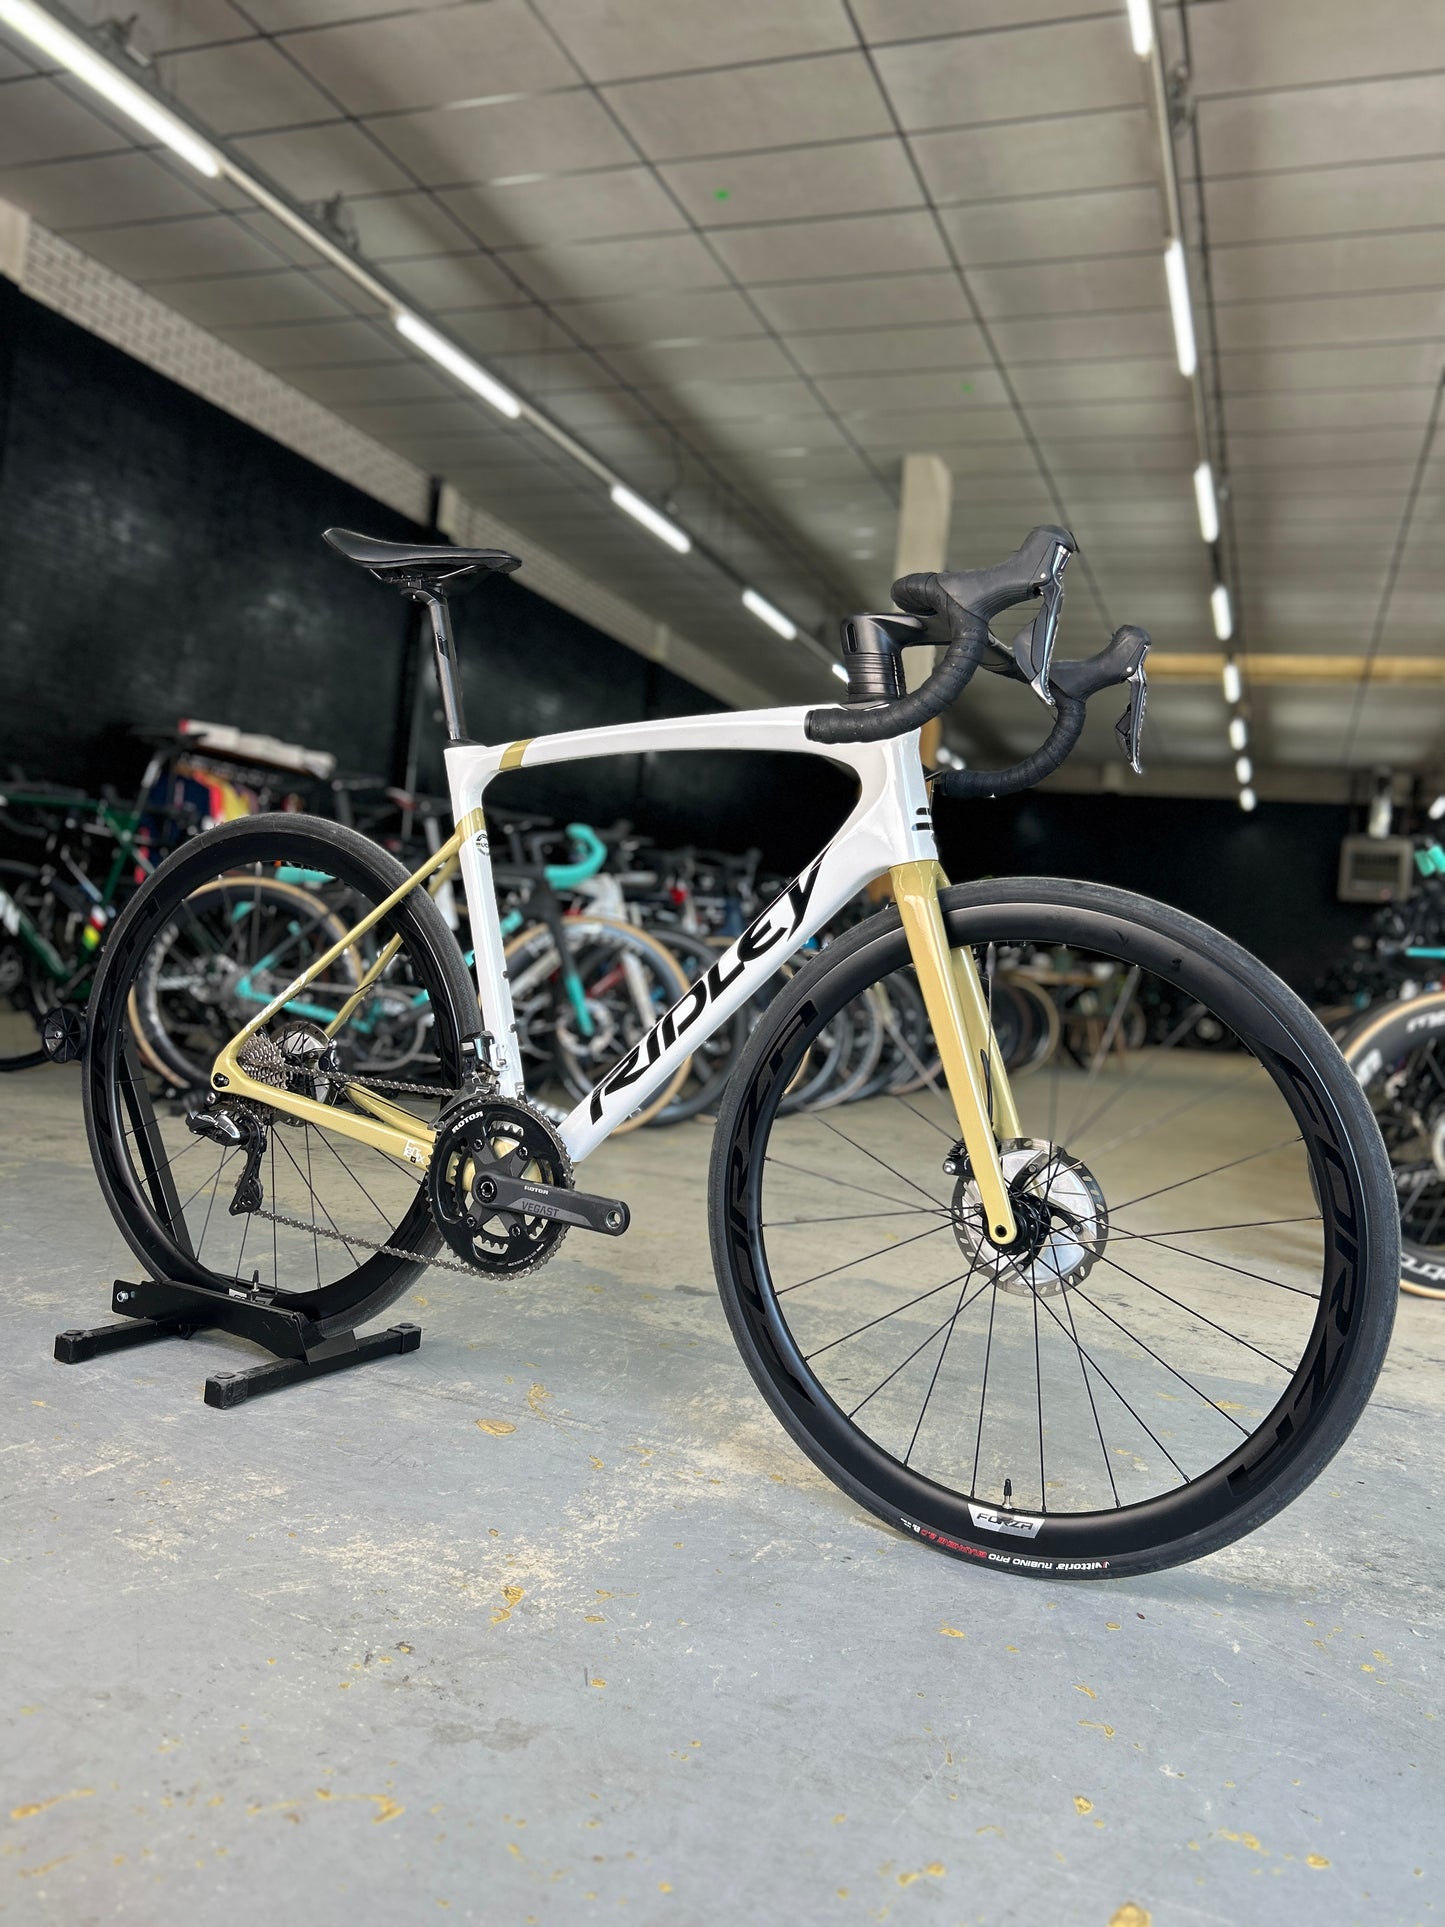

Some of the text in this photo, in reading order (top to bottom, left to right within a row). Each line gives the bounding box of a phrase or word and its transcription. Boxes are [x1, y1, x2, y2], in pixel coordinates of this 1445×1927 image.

[590, 841, 834, 1125] RIDLEY
[451, 1110, 484, 1134] ROTOR
[524, 1184, 549, 1195] ROTOR
[521, 1200, 560, 1218] VEGAST
[976, 1512, 1034, 1531] FORZA
[987, 1552, 1010, 1564] PRO
[1012, 1557, 1052, 1570] RUBINO
